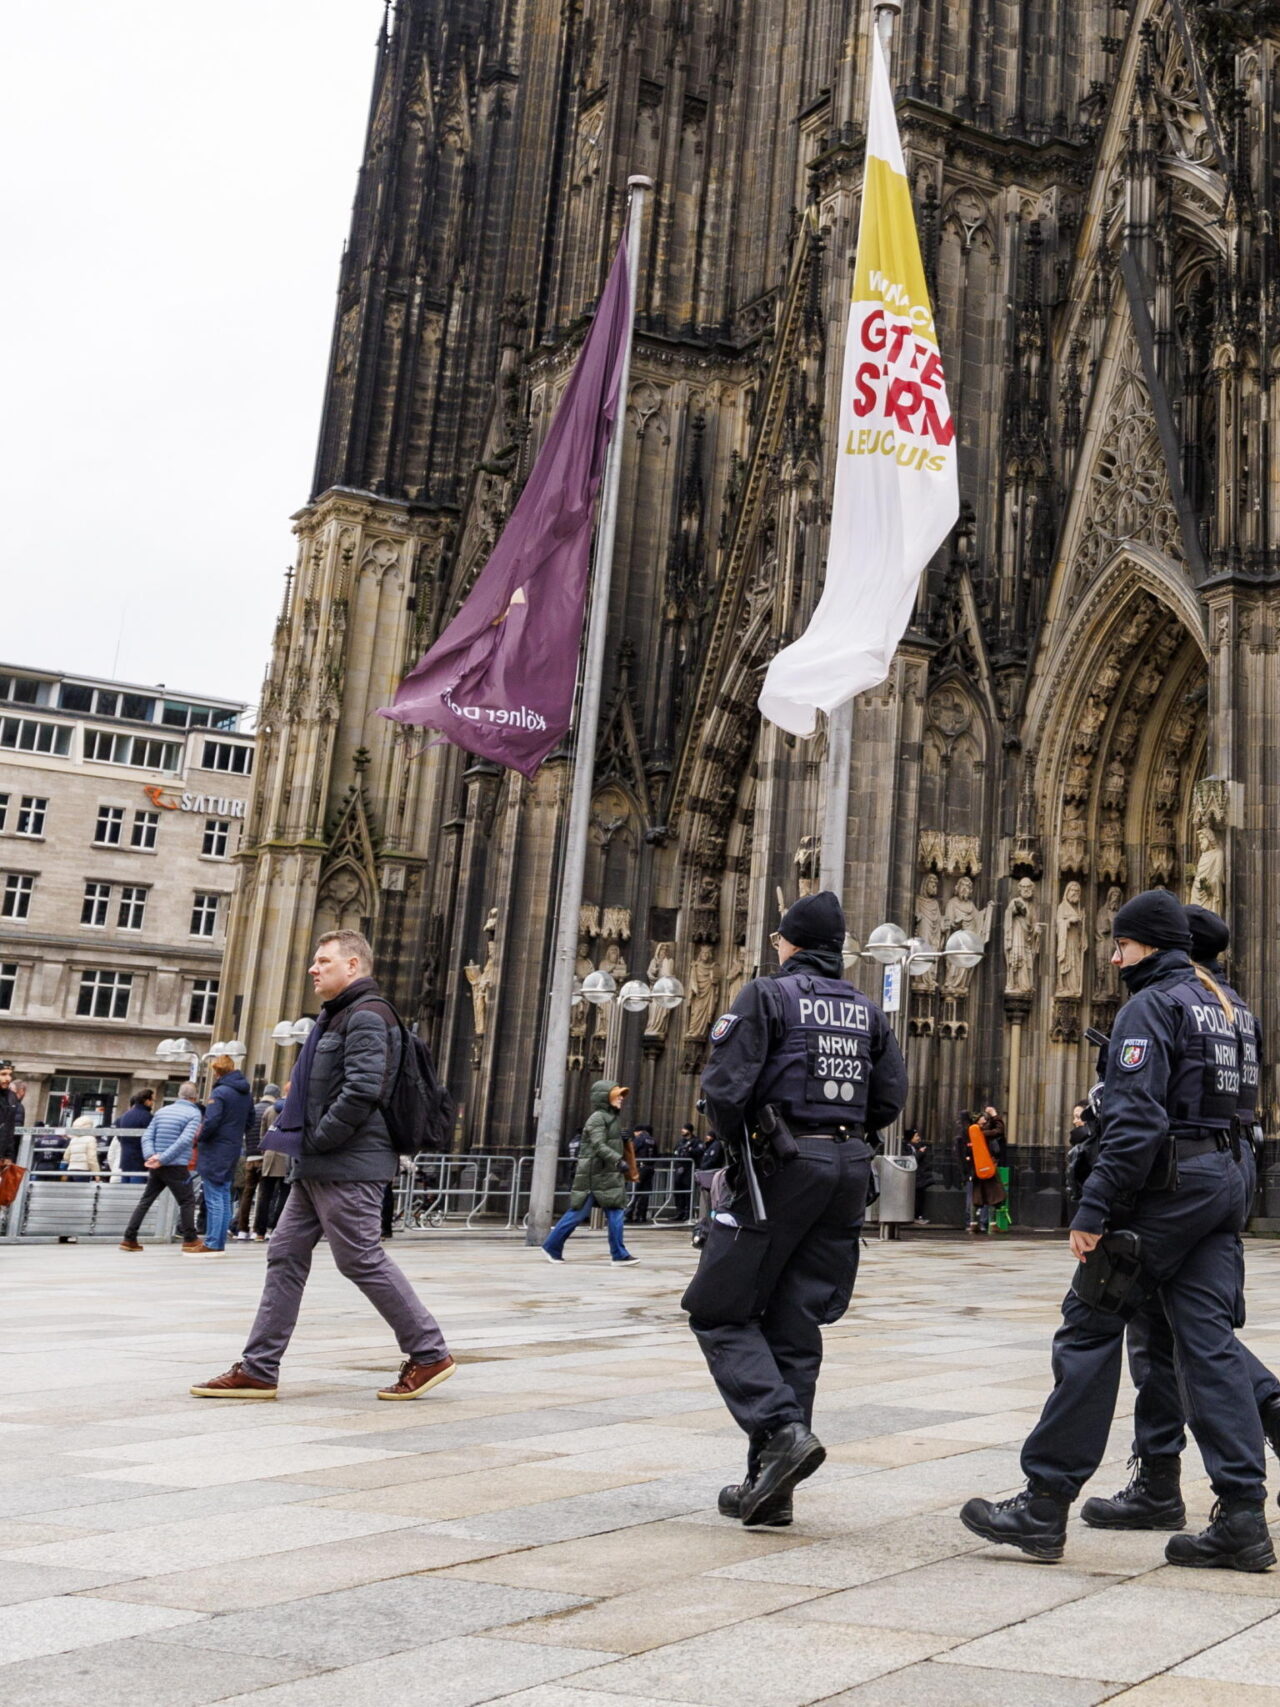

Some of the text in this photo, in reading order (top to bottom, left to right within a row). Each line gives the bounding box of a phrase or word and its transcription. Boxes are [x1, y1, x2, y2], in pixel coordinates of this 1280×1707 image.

[799, 998, 869, 1031] POLIZEI
[818, 1035, 858, 1056] NRW
[1214, 1043, 1236, 1067] NRW
[817, 1056, 862, 1080] 31232
